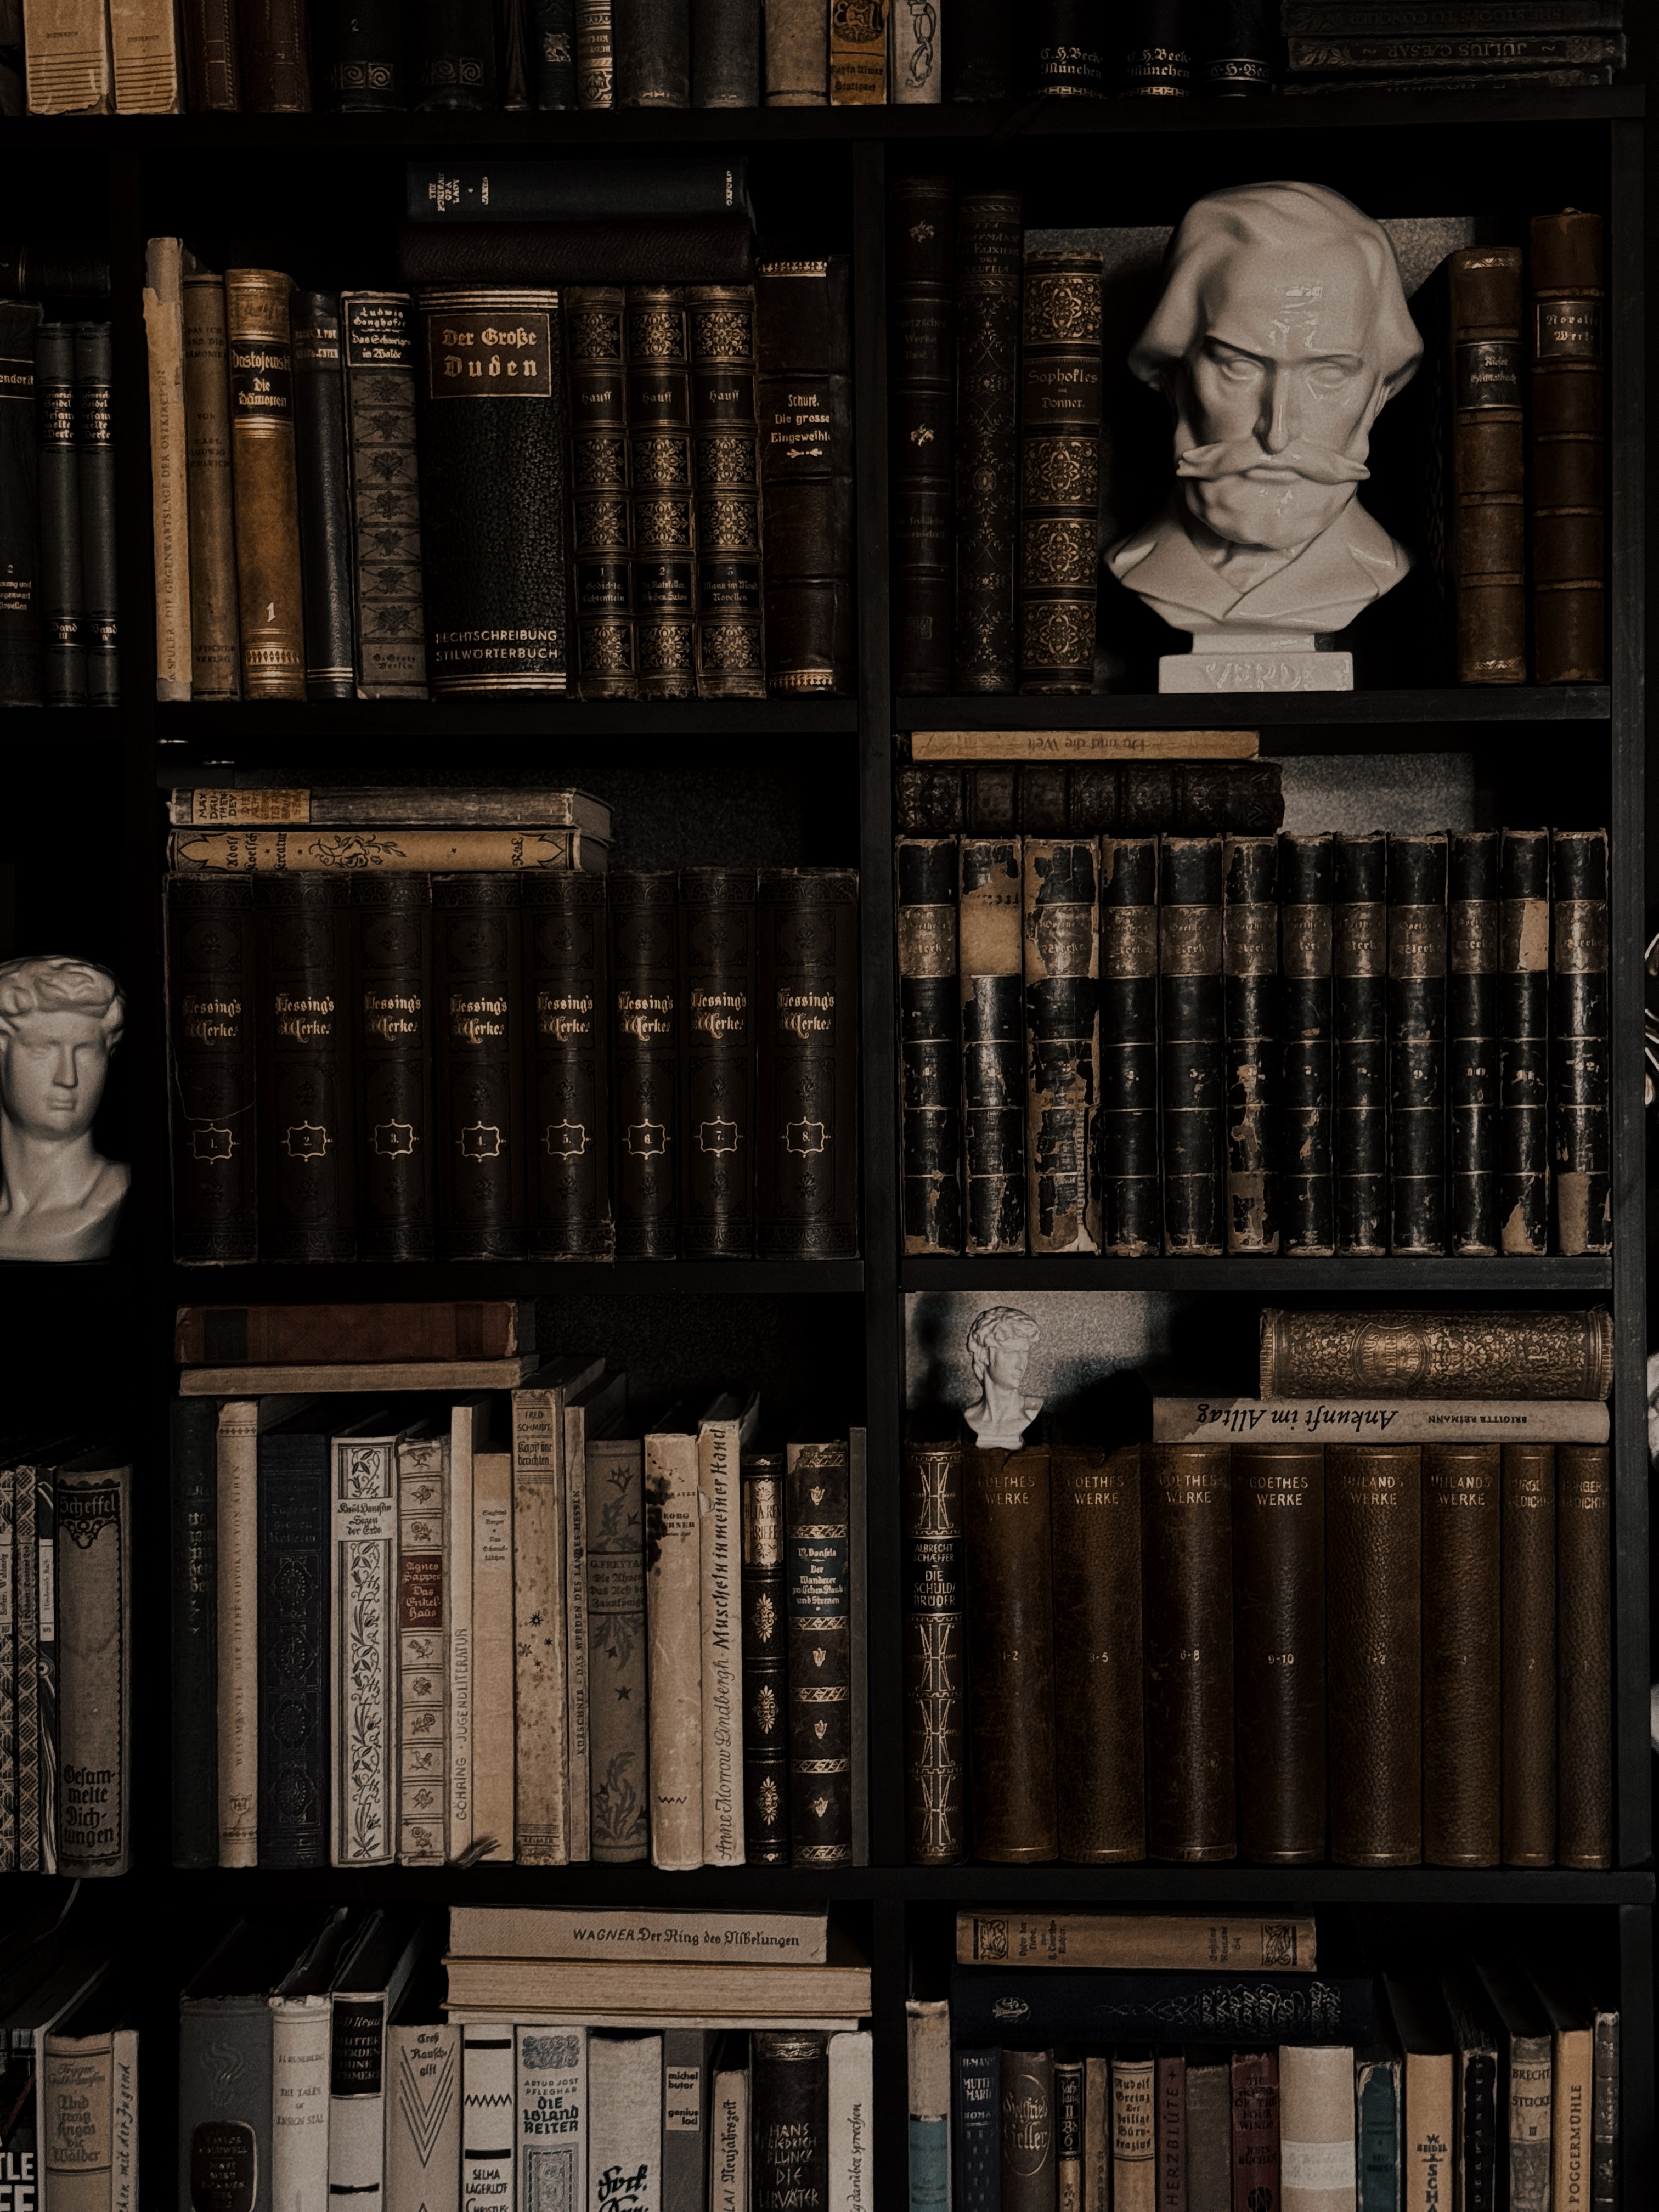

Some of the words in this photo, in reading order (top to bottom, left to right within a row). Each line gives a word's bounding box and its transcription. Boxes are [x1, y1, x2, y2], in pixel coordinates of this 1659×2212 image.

[351, 18, 359, 32] 2
[1388, 44, 1452, 58] CÆSAR
[1459, 42, 1527, 56] JULIUS
[1041, 61, 1102, 79] München
[1127, 62, 1190, 79] München
[964, 265, 1009, 274] TEUFELS
[360, 307, 404, 320] Ludwig
[353, 317, 407, 329] Ganghofer
[352, 334, 370, 344] Das
[442, 328, 475, 347] Der
[481, 327, 538, 349] Große
[362, 350, 373, 358] im
[374, 348, 402, 360] Walde
[443, 354, 538, 378] Duden
[1028, 368, 1098, 386] Sophokles
[253, 378, 271, 392] Die
[238, 392, 287, 408] Dämonen
[1042, 397, 1086, 408] Donner.
[775, 414, 792, 424] Die
[795, 415, 830, 426] grosse
[161, 454, 171, 478] DER
[162, 482, 174, 593] GEGENWARTSLAGE
[659, 567, 665, 576] 2
[713, 593, 748, 602] Novellen
[267, 602, 276, 623] 1
[49, 623, 77, 633] Band
[89, 624, 117, 635] Band
[435, 630, 558, 644] RECHTSCHREIBUNG
[167, 628, 176, 669] SPULER
[436, 648, 558, 662] STILWÖRTERBUCH
[1028, 737, 1059, 751] Welt
[1064, 737, 1086, 751] die
[1091, 737, 1118, 751] und
[1124, 737, 1146, 752] Du
[199, 793, 207, 819] MAX
[229, 794, 237, 817] DEY
[227, 835, 238, 867] Adolf
[245, 833, 257, 871] Koelsch
[275, 832, 287, 871] Kreatur
[183, 994, 241, 1018] Lessing's
[275, 992, 335, 1016] Lessing's
[364, 991, 422, 1014] Lessing's
[644, 1133, 653, 1144] 6.
[716, 1130, 724, 1141] 7.
[802, 1131, 811, 1142] 8.
[525, 1410, 543, 1419] FRED
[1196, 1403, 1267, 1432] Alltag
[1271, 1409, 1299, 1431] im
[1305, 1405, 1399, 1432] Ankunft
[1427, 1415, 1477, 1424] REIMANN
[1480, 1415, 1527, 1424] BRIGITTE
[517, 1423, 551, 1432] SCHMIDT
[709, 1429, 727, 1476] Hand
[517, 1454, 549, 1466] berichten
[1249, 1477, 1308, 1489] GOETHES
[985, 1492, 1030, 1505] WERKE
[1074, 1492, 1120, 1505] WERKE
[1166, 1491, 1211, 1504] WERKE
[1256, 1493, 1303, 1506] WERKE
[1350, 1493, 1397, 1506] WERKE
[1438, 1493, 1486, 1505] WERKE
[59, 1493, 117, 1518] Scheffel
[573, 1490, 581, 1531] HESSEN
[714, 1478, 728, 1539] meiner
[348, 1516, 379, 1527] Segen
[347, 1526, 360, 1536] der
[362, 1526, 383, 1535] Erde
[712, 1542, 728, 1559] in
[809, 1547, 838, 1557] Bonsels
[914, 1543, 954, 1553] ALBRECHT
[573, 1536, 582, 1576] LANDES
[913, 1553, 955, 1563] SCHÆFFER
[405, 1561, 438, 1572] Agnes
[810, 1564, 825, 1575] Der
[403, 1571, 442, 1582] Sapper
[593, 1574, 610, 1583] Die
[799, 1575, 837, 1584] Wanderer
[925, 1570, 944, 1582] DIE
[413, 1586, 434, 1596] Das
[589, 1586, 608, 1595] Das
[792, 1585, 823, 1595] zwischen
[824, 1584, 844, 1594] Staub
[405, 1596, 441, 1607] Enkel-
[711, 1562, 730, 1650] Muscheln
[796, 1596, 811, 1604] und
[812, 1596, 840, 1605] Sternen
[913, 1594, 956, 1607] BRÜDER
[574, 1606, 583, 1650] WERDEN
[1003, 1650, 1019, 1661] 1-2
[1089, 1652, 1108, 1663] 3-5
[1180, 1650, 1200, 1661] 6-8
[1267, 1653, 1294, 1664] 9-10
[575, 1655, 584, 1677] DAS
[453, 1628, 468, 1742] JUGENDLITERATUR
[712, 1658, 735, 1747] Lindbergh
[64, 1764, 116, 1787] Gesam-
[715, 1749, 731, 1813] Morrow
[68, 1786, 108, 1803] melte
[453, 1757, 467, 1821] GÖHRING
[66, 1805, 107, 1828] Dich-
[64, 1827, 114, 1847] tungen
[715, 1815, 732, 1862] Anne
[572, 1928, 635, 1941] WAGNER
[635, 1926, 662, 1941] Der
[663, 1928, 699, 1945] Ring
[703, 1930, 721, 1944] des
[723, 1930, 800, 1948] Nibelungen
[1019, 1936, 1028, 1957] Opfer
[668, 2070, 698, 2080] michel
[1512, 2068, 1551, 2081] BRECHT
[556, 2078, 579, 2086] JOST
[668, 2081, 694, 2090] butor
[1114, 2077, 1150, 2090] Rudolf
[116, 2062, 134, 2123] Jugend
[297, 2086, 321, 2097] TALES
[526, 2087, 577, 2095] PFLEGHAR
[1116, 2091, 1150, 2103] Greinz
[57, 2094, 89, 2110] Und
[537, 2096, 562, 2110] DIE
[668, 2109, 699, 2119] genius
[681, 2117, 698, 2125] loci
[1116, 2113, 1150, 2125] heilige
[57, 2123, 96, 2138] singen
[523, 2120, 579, 2134] REITER
[769, 2122, 810, 2137] HANS
[1239, 2120, 1274, 2130] WINDS
[116, 2122, 130, 2147] der
[720, 2098, 739, 2183] Neujahrszeit
[1426, 2134, 1440, 2144] W
[50, 2146, 100, 2163] Wälder
[1162, 2088, 1180, 2207] HERZBLÜTE
[117, 2151, 130, 2176] mit
[473, 2168, 501, 2180] SELMA
[775, 2166, 803, 2186] DIE
